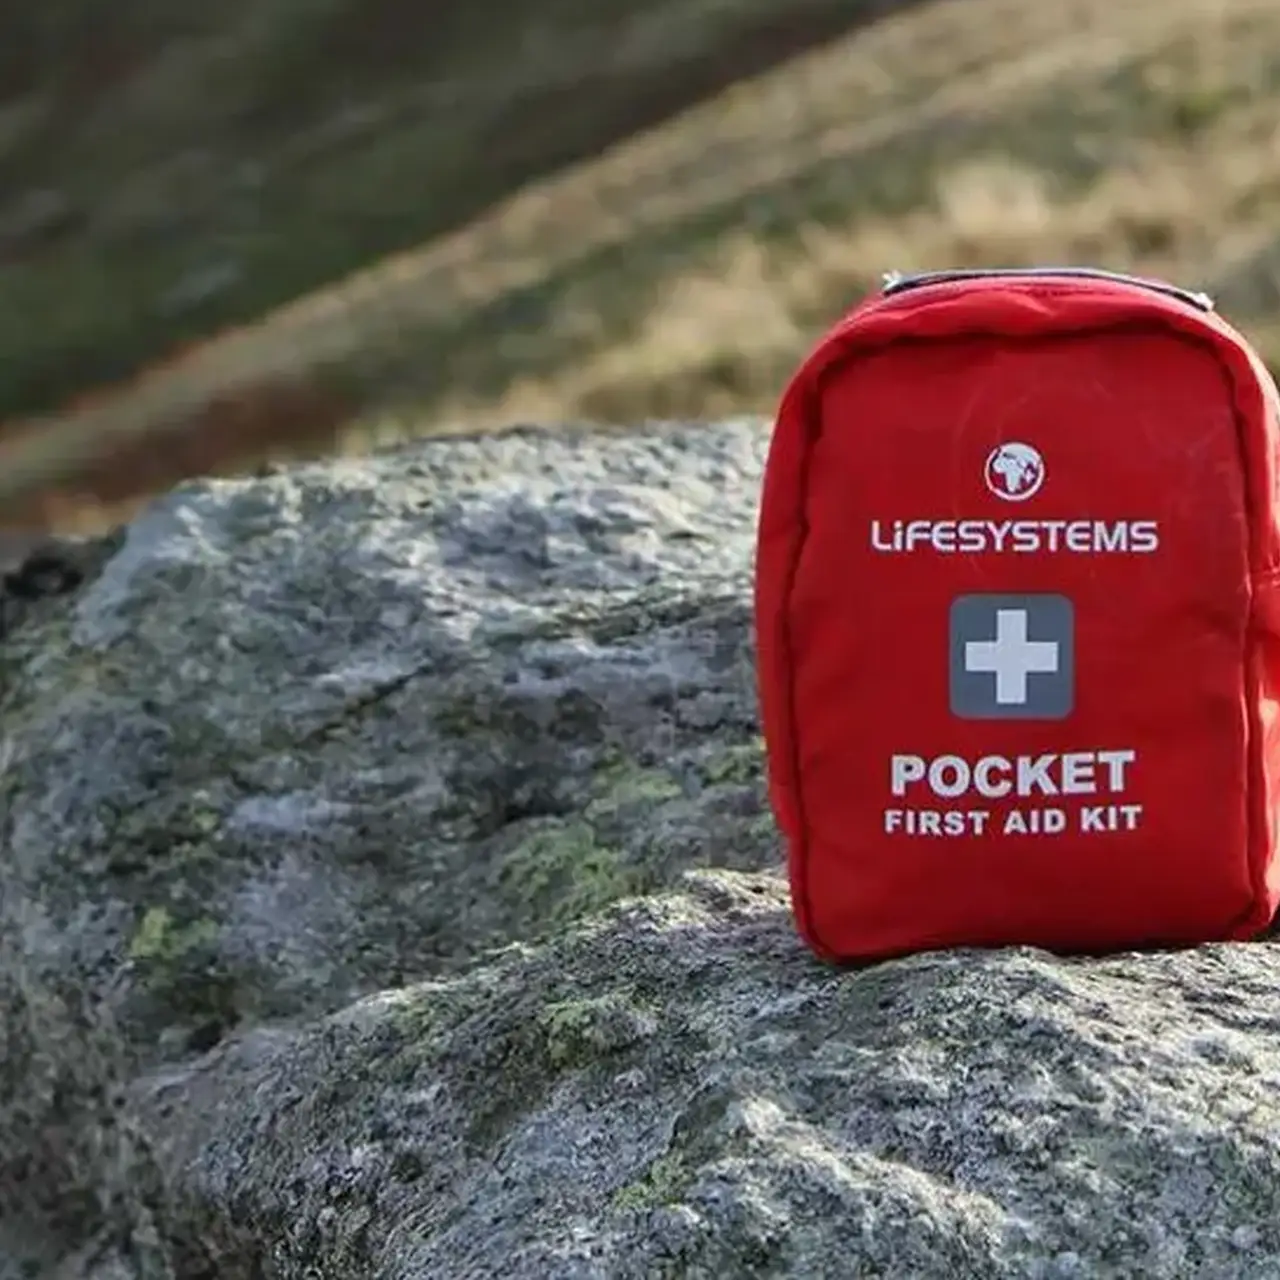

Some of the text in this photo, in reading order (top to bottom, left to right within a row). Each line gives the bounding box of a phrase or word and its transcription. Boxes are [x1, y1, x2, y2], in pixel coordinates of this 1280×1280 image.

[890, 749, 1136, 798] POCKET
[884, 805, 1143, 836] FIRST AID KIT
